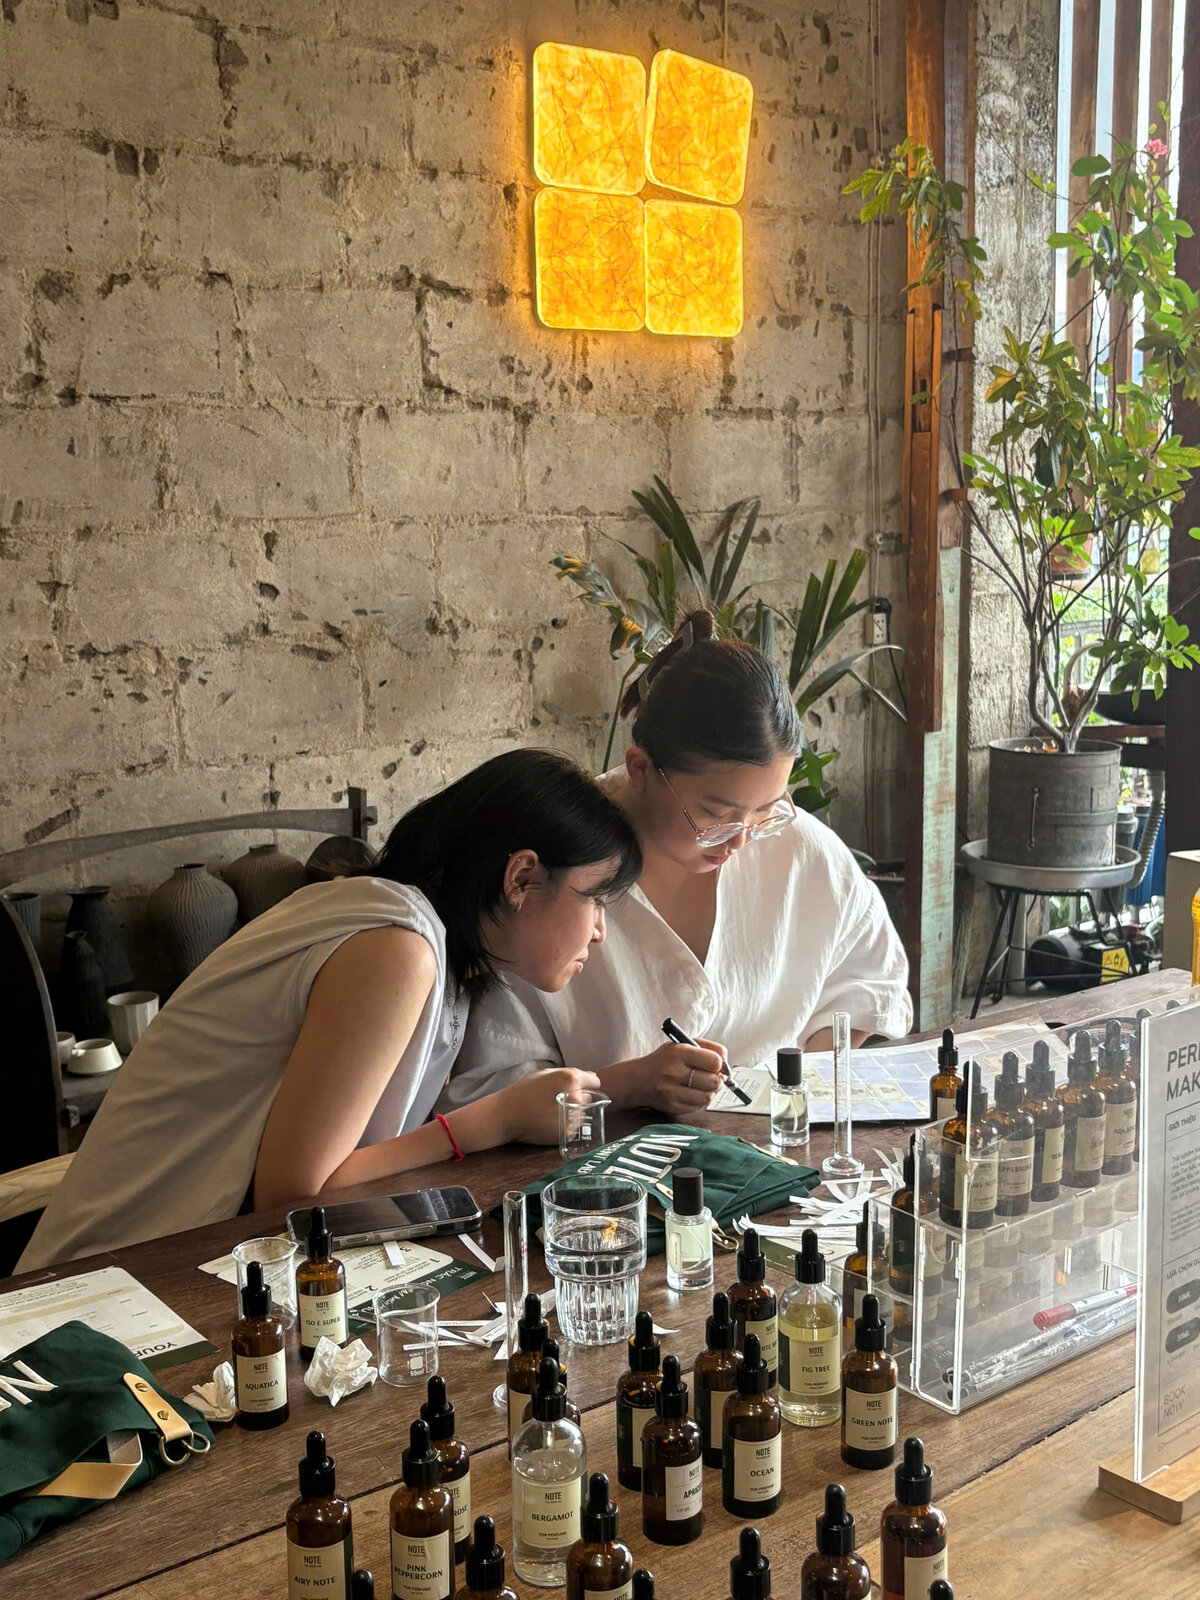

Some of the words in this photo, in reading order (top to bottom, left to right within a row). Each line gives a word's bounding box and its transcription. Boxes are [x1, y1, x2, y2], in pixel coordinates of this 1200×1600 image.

[1167, 1041, 1200, 1073] PER
[316, 1301, 329, 1309] NOTE
[323, 1316, 341, 1326] SUPER
[809, 1347, 823, 1355] NOTE
[253, 1362, 268, 1372] NOTE
[815, 1365, 830, 1373] TREE
[244, 1379, 279, 1391] AQUATICA
[1163, 1384, 1186, 1405] BOOK
[866, 1400, 881, 1408] NOTE
[1163, 1400, 1184, 1419] NOW
[851, 1417, 875, 1427] GREEN
[876, 1416, 893, 1427] NOTE
[755, 1447, 770, 1457] NOTE
[750, 1466, 774, 1477] OCEAN
[545, 1492, 562, 1500] NOTE
[531, 1511, 574, 1522] BERGAMOT
[408, 1545, 425, 1554] NOTE
[304, 1555, 321, 1565] NOTE
[394, 1566, 443, 1580] PEPPERCORN
[407, 1564, 427, 1572] PINK
[294, 1575, 311, 1586] AIRY
[312, 1575, 337, 1587] NOTE
